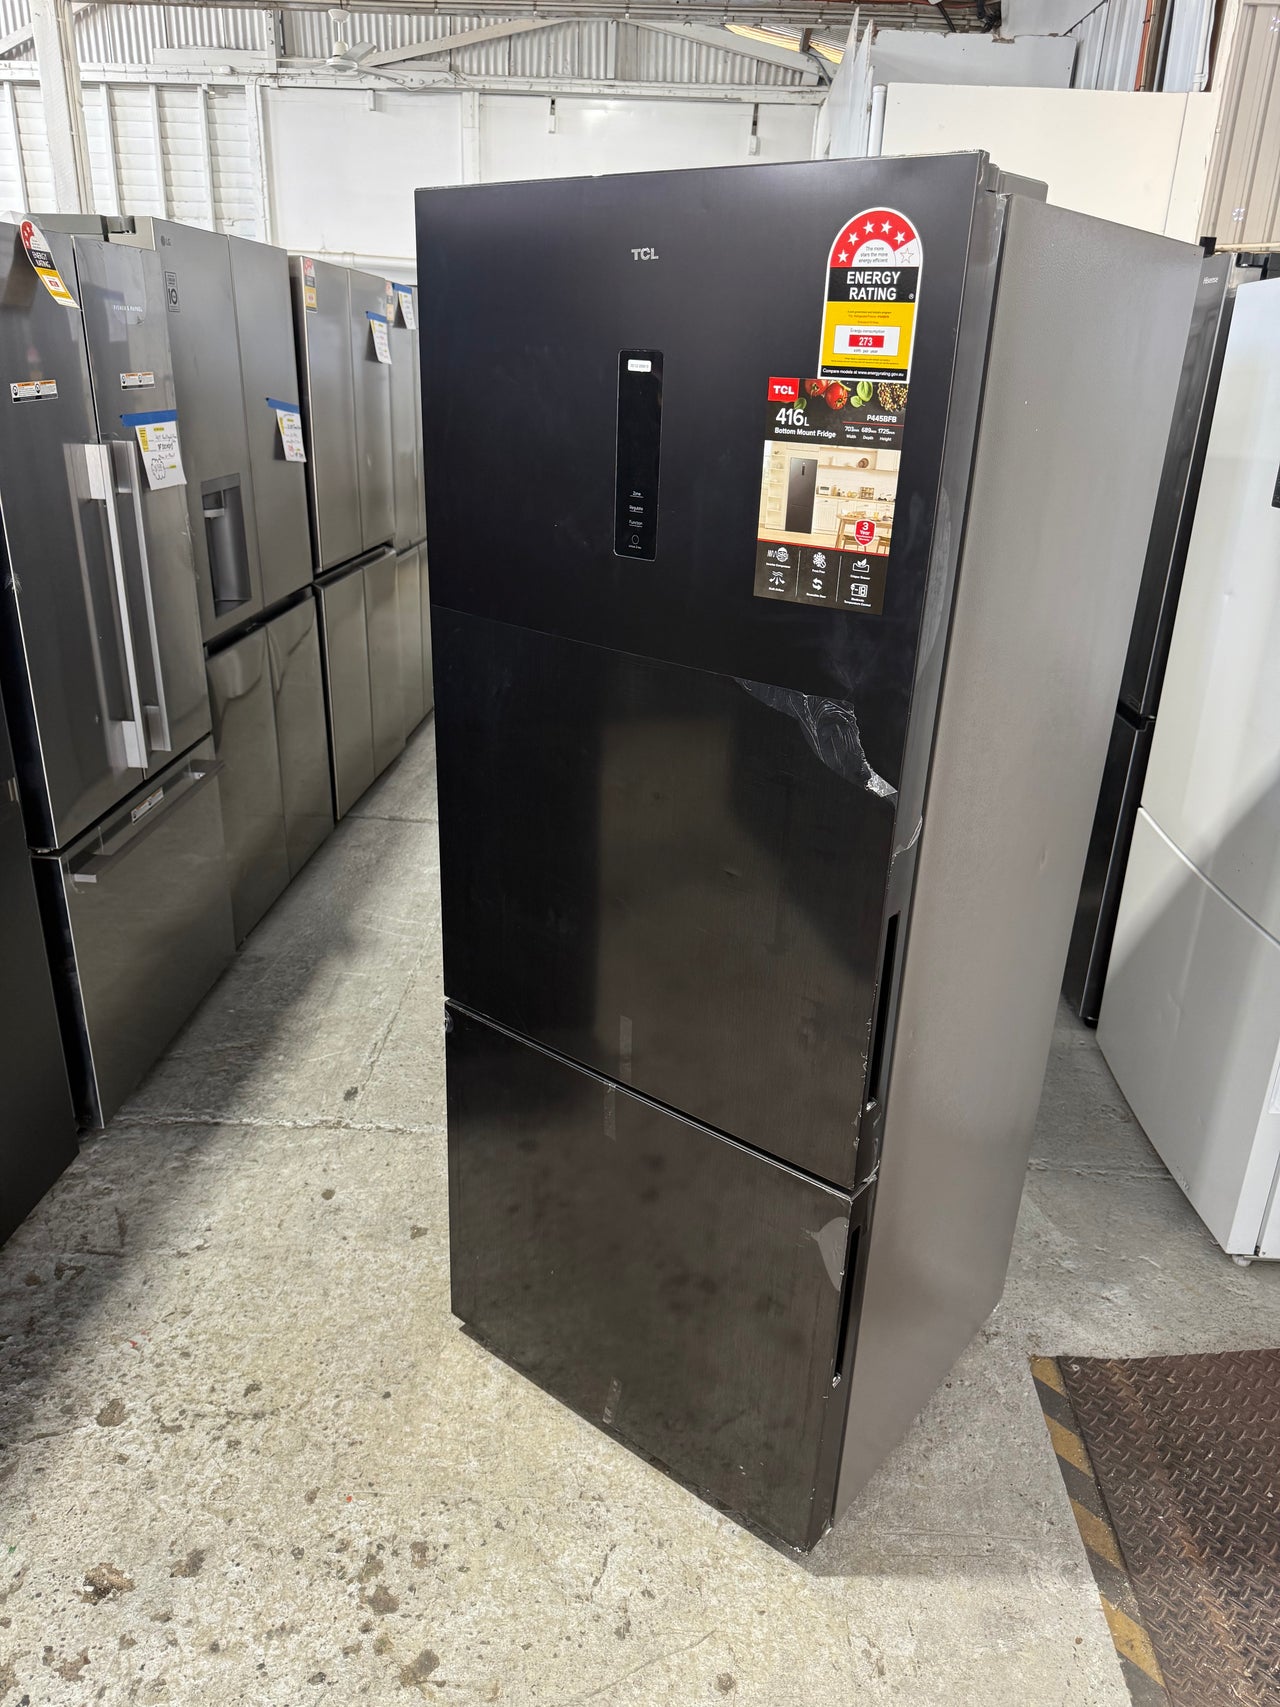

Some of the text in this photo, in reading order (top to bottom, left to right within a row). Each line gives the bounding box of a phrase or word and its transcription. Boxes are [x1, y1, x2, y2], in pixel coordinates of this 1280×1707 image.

[630, 247, 659, 261] TCL
[846, 271, 901, 285] ENERGY
[849, 287, 897, 301] RATING
[858, 336, 873, 346] 273
[773, 385, 795, 395] TCL
[775, 407, 810, 427] 416L
[774, 426, 837, 439] Bottom Mount Fridge
[862, 521, 869, 530] 3
